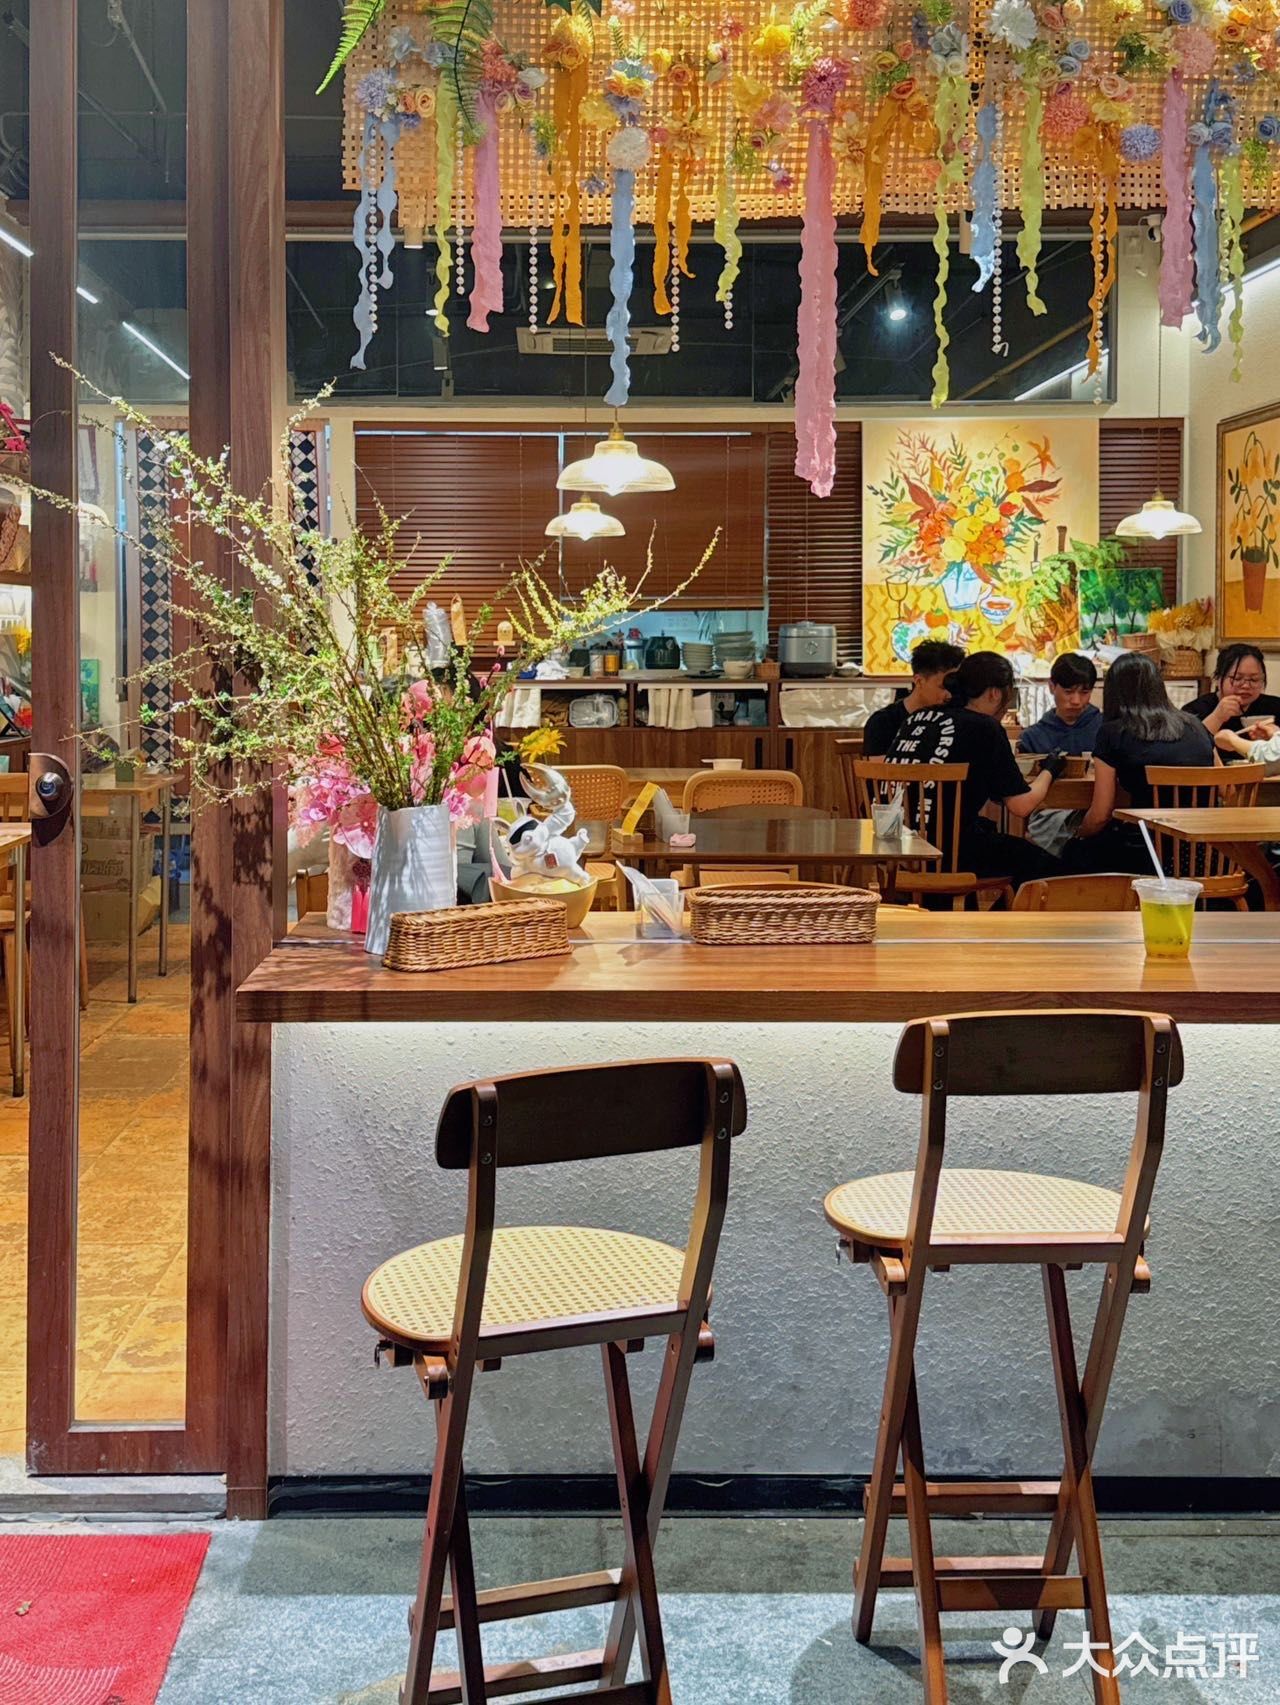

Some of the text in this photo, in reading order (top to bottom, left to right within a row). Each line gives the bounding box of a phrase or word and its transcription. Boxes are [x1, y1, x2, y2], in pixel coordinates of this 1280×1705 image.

[906, 710, 944, 725] THAT
[911, 726, 926, 736] IS
[896, 740, 920, 752] THE
